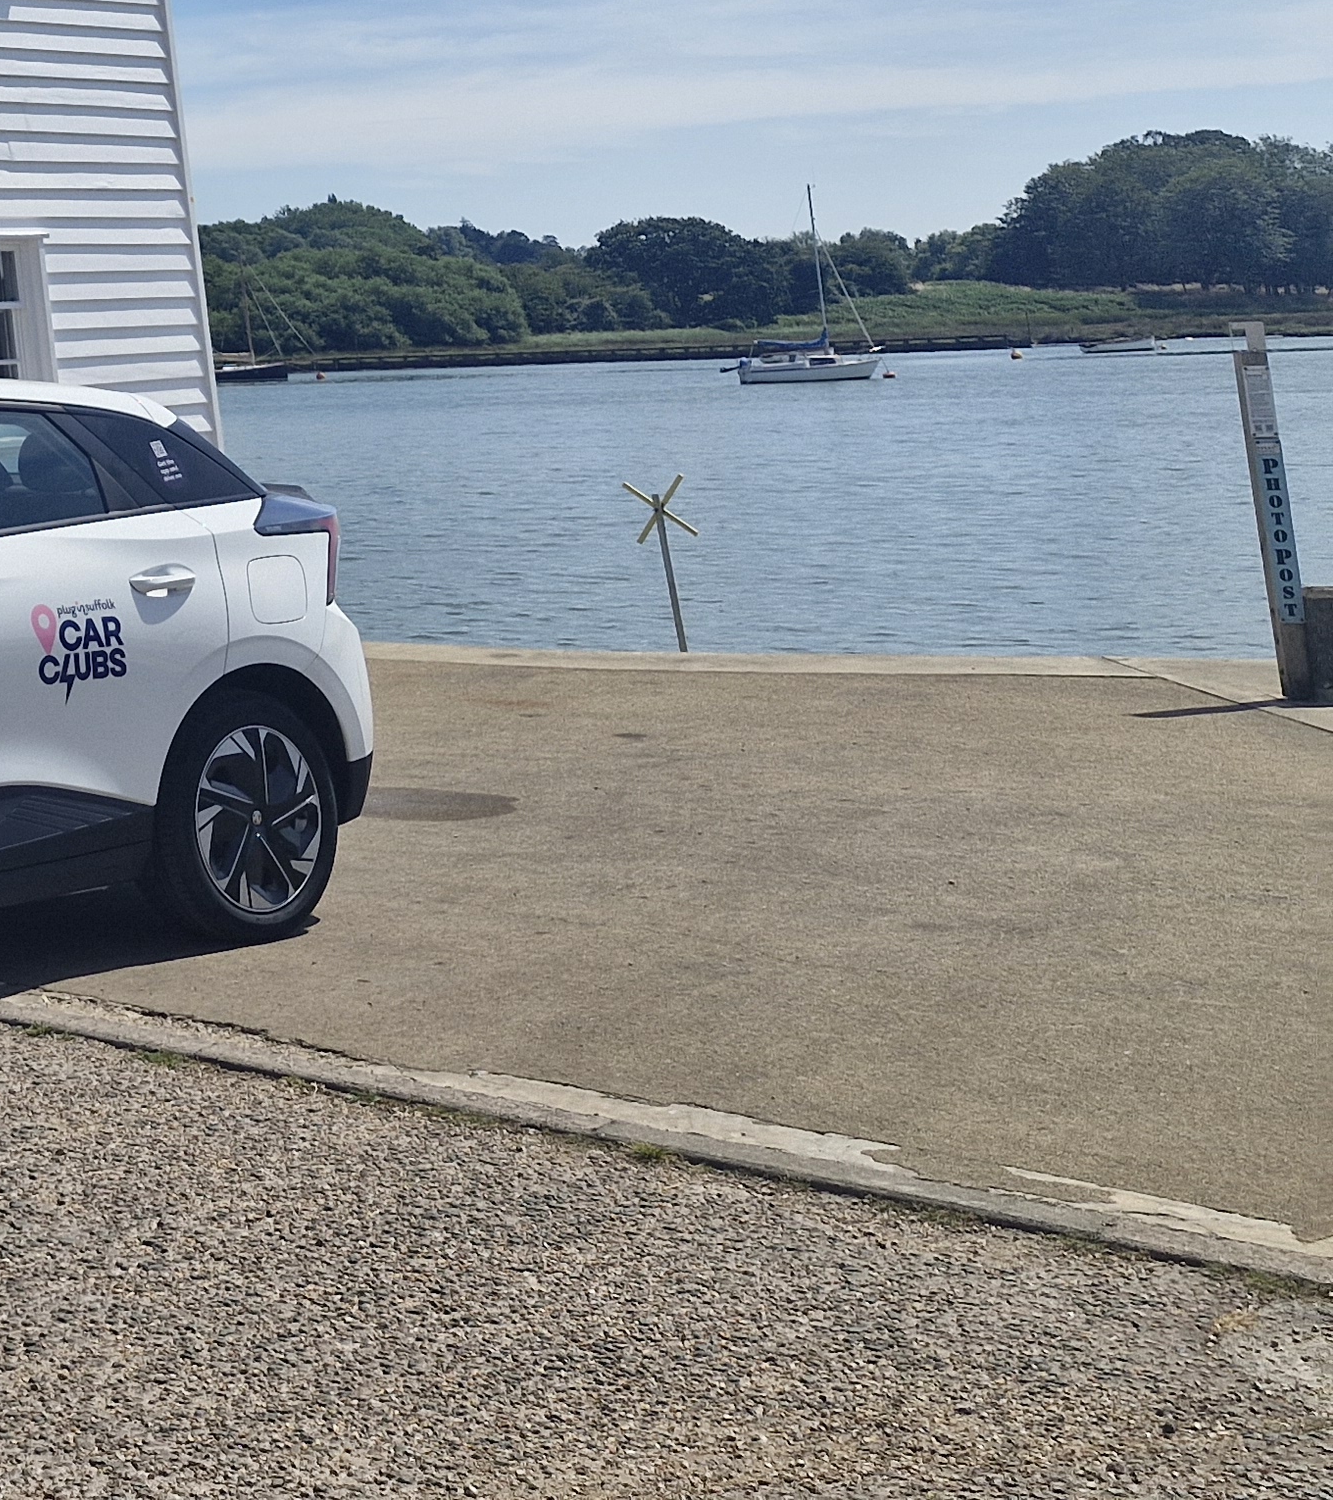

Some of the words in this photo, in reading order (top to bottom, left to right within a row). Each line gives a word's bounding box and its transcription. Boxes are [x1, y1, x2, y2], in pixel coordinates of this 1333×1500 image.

[1262, 457, 1297, 618] PHOTOPOST
[59, 616, 124, 651] CAR
[38, 648, 127, 702] CLUBS
